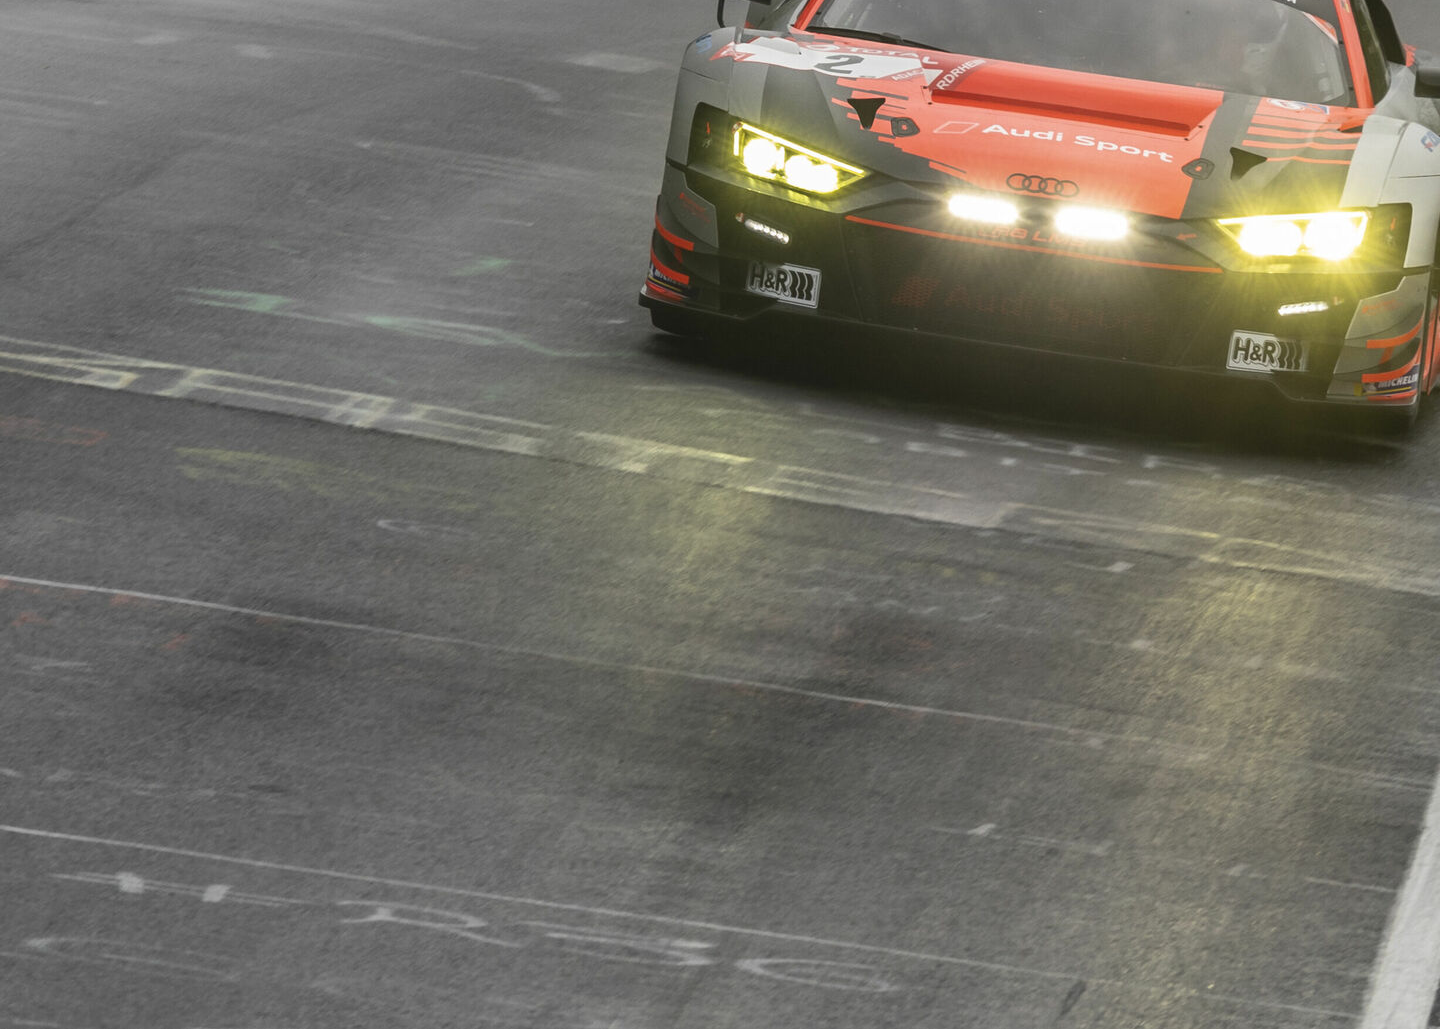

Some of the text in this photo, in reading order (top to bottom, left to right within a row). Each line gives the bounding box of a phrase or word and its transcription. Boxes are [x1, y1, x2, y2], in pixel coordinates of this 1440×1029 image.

[814, 54, 865, 75] 2
[981, 124, 1174, 163] Audi Sport
[751, 261, 791, 297] H&R
[1231, 336, 1278, 368] H&R
